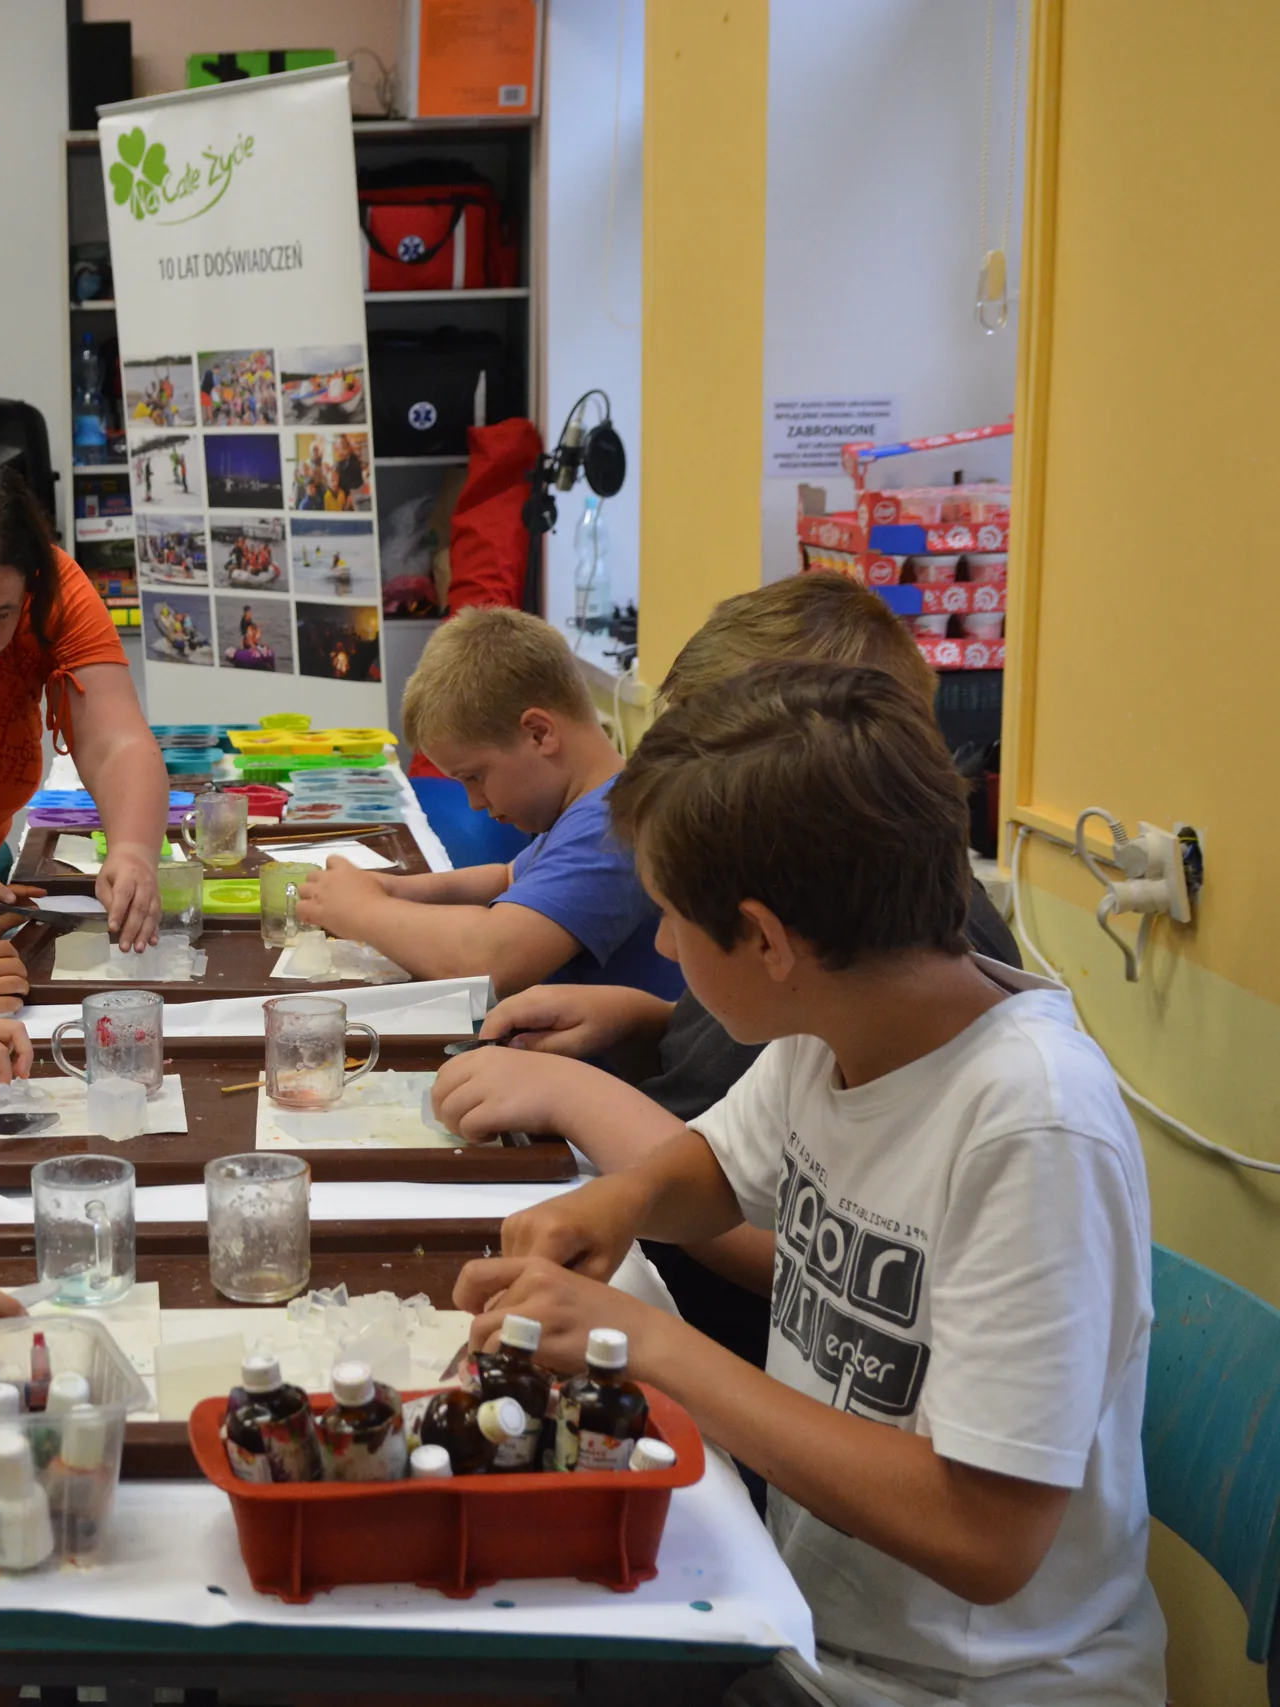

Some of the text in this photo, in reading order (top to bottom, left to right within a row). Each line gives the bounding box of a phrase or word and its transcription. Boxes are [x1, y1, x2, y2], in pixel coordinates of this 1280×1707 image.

[202, 133, 254, 187] Życie
[159, 241, 303, 281] 10 LAT DOŚWIADCZEŃ
[787, 424, 876, 438] ZABRONIONE
[838, 1198, 900, 1233] ESTABLISHED
[826, 1334, 895, 1384] enter
